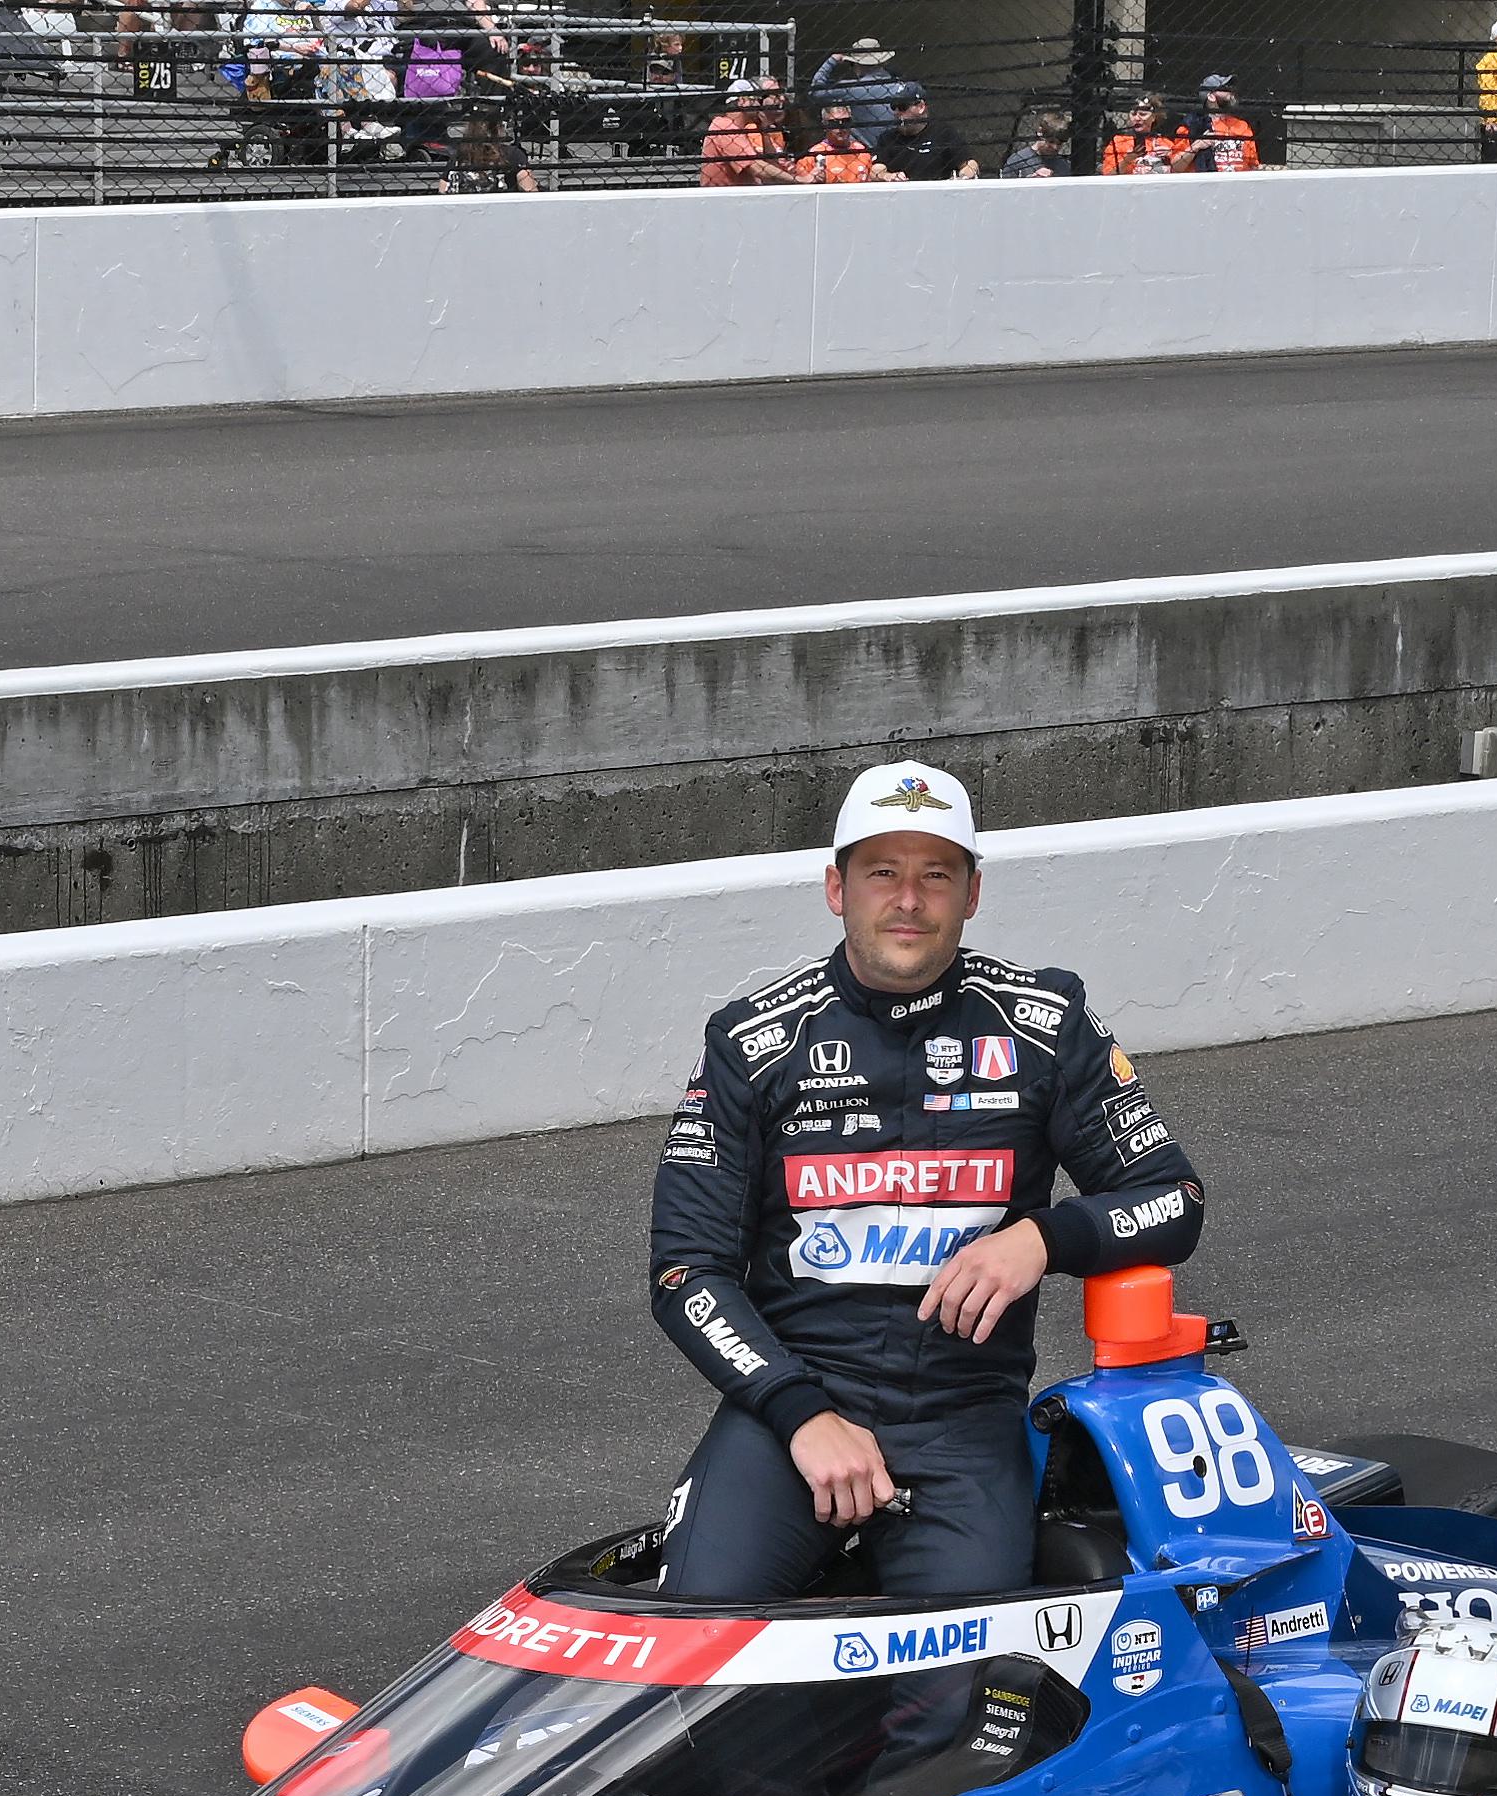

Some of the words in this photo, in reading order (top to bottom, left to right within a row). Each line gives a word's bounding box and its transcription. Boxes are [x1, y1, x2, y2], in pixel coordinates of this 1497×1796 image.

[150, 62, 172, 89] 26
[1014, 1003, 1062, 1030] OMP
[742, 1026, 786, 1056] OMP
[797, 1075, 869, 1092] HONDA
[1129, 1122, 1169, 1153] CURB
[798, 1159, 1004, 1198] ANDRETTI
[1133, 1189, 1185, 1230] MAPEI
[701, 1316, 768, 1376] MAPEI
[1142, 1388, 1275, 1518] 98
[1197, 1590, 1218, 1608] PPG
[1269, 1608, 1325, 1638] Andretti
[887, 1617, 989, 1664] MAPEI
[1134, 1631, 1157, 1646] NTT
[1112, 1649, 1162, 1670] INDYCAR
[985, 1703, 1027, 1723] SIEMENS
[1433, 1698, 1489, 1722] MAPEI
[984, 1742, 1014, 1757] MAPEI
